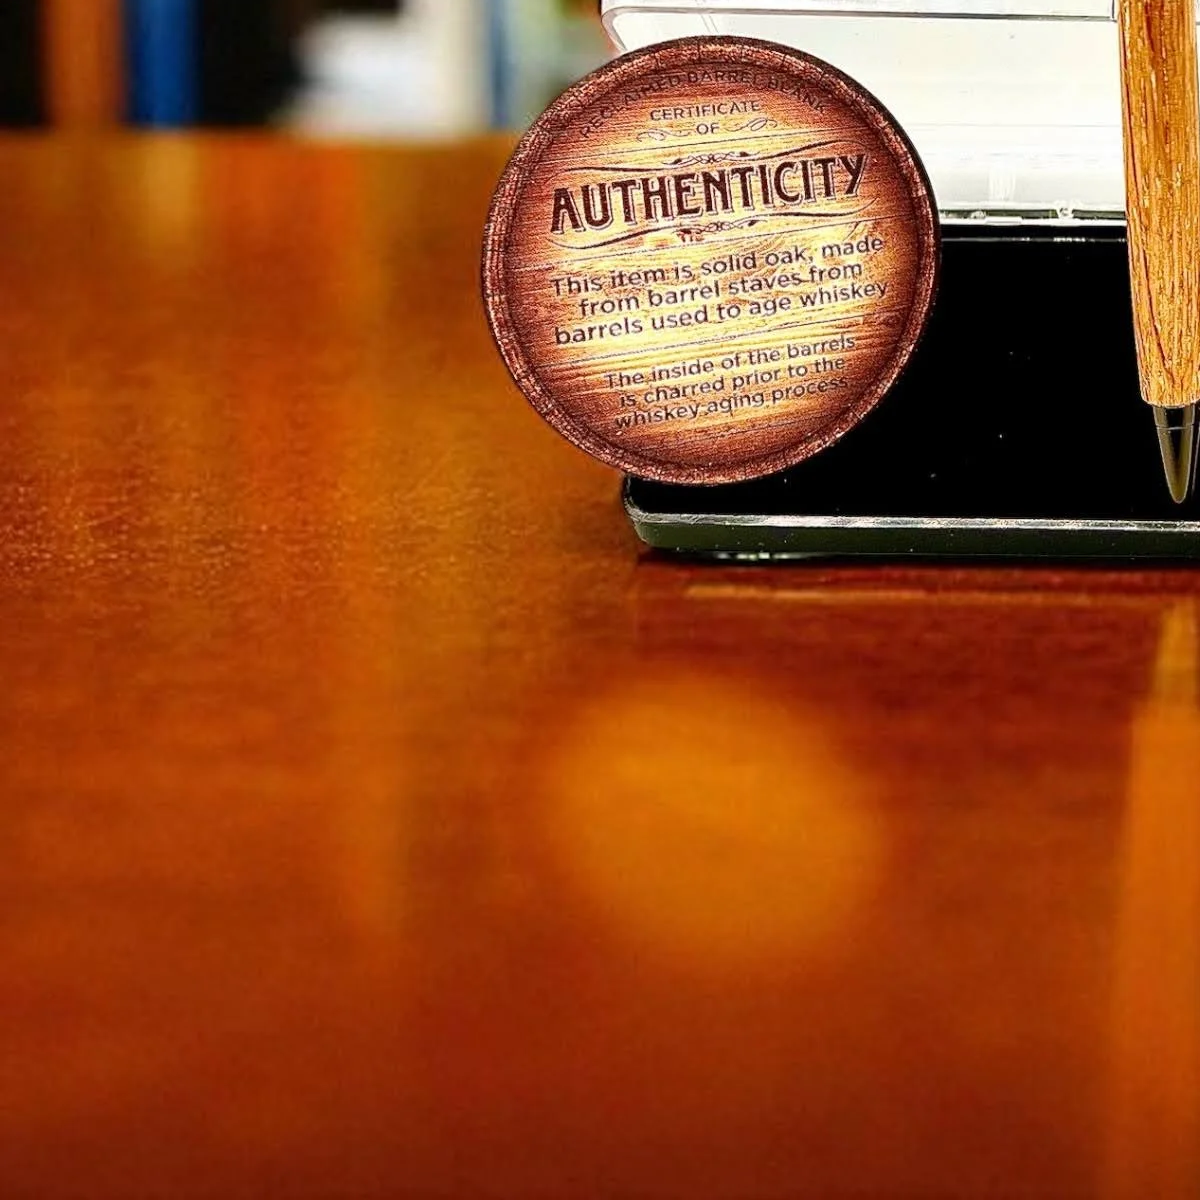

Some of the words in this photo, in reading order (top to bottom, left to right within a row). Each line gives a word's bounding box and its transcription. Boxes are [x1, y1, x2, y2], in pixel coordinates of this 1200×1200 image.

[650, 101, 760, 121] CERTIFICATE
[696, 122, 720, 135] OF
[550, 152, 868, 235] AUTHENTICITY
[550, 275, 602, 297] This
[611, 270, 665, 289] item
[674, 261, 693, 279] is
[701, 252, 757, 276] solid
[765, 246, 814, 267] oak,
[821, 236, 884, 259] made
[579, 296, 640, 317] from
[649, 282, 720, 307] barrel
[728, 271, 801, 295] staves
[807, 263, 862, 284] from
[554, 318, 643, 345] barrels
[651, 306, 708, 330] used
[718, 303, 741, 323] to
[750, 296, 791, 317] age
[799, 280, 889, 308] whiskey
[604, 373, 644, 389] The
[651, 359, 714, 382] inside
[721, 354, 742, 369] of
[749, 348, 780, 366] the
[787, 334, 855, 359] barrels
[620, 393, 637, 408] is
[644, 376, 725, 404] charred
[732, 368, 781, 395] prior
[788, 363, 808, 378] to
[815, 356, 846, 374] the
[615, 404, 700, 430] whiskey
[706, 391, 765, 415] aging
[772, 377, 848, 404] process
